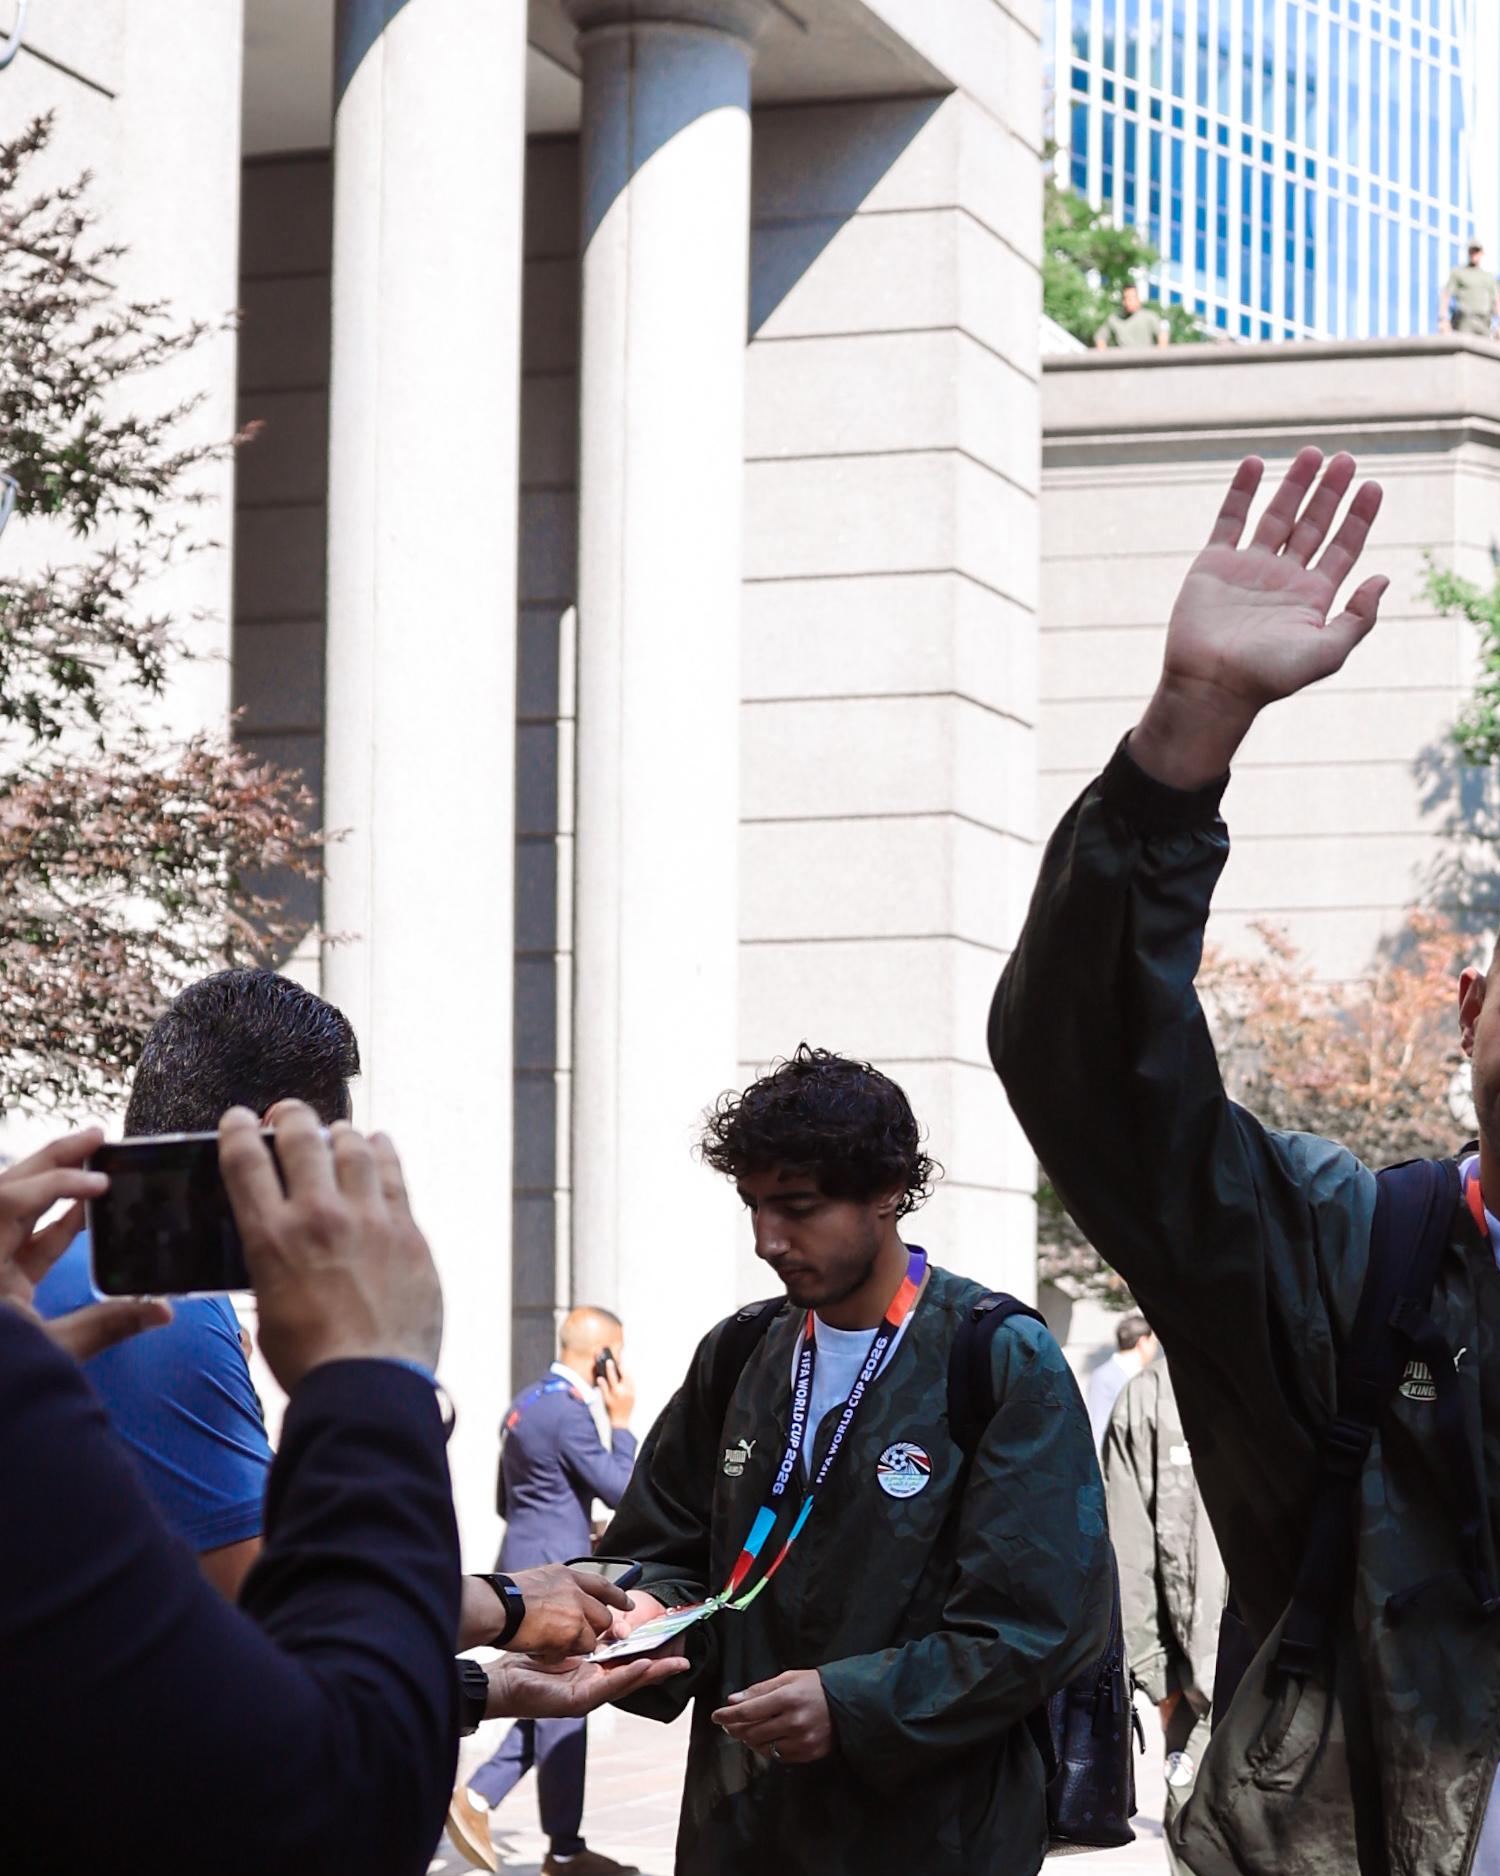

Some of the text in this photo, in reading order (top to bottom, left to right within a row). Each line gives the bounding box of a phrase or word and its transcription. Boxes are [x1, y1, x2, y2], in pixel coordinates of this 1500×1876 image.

[772, 1350, 811, 1495] FIFA WORLD CUP 2026
[816, 1337, 888, 1483] FIFA WORLD CUP 2026
